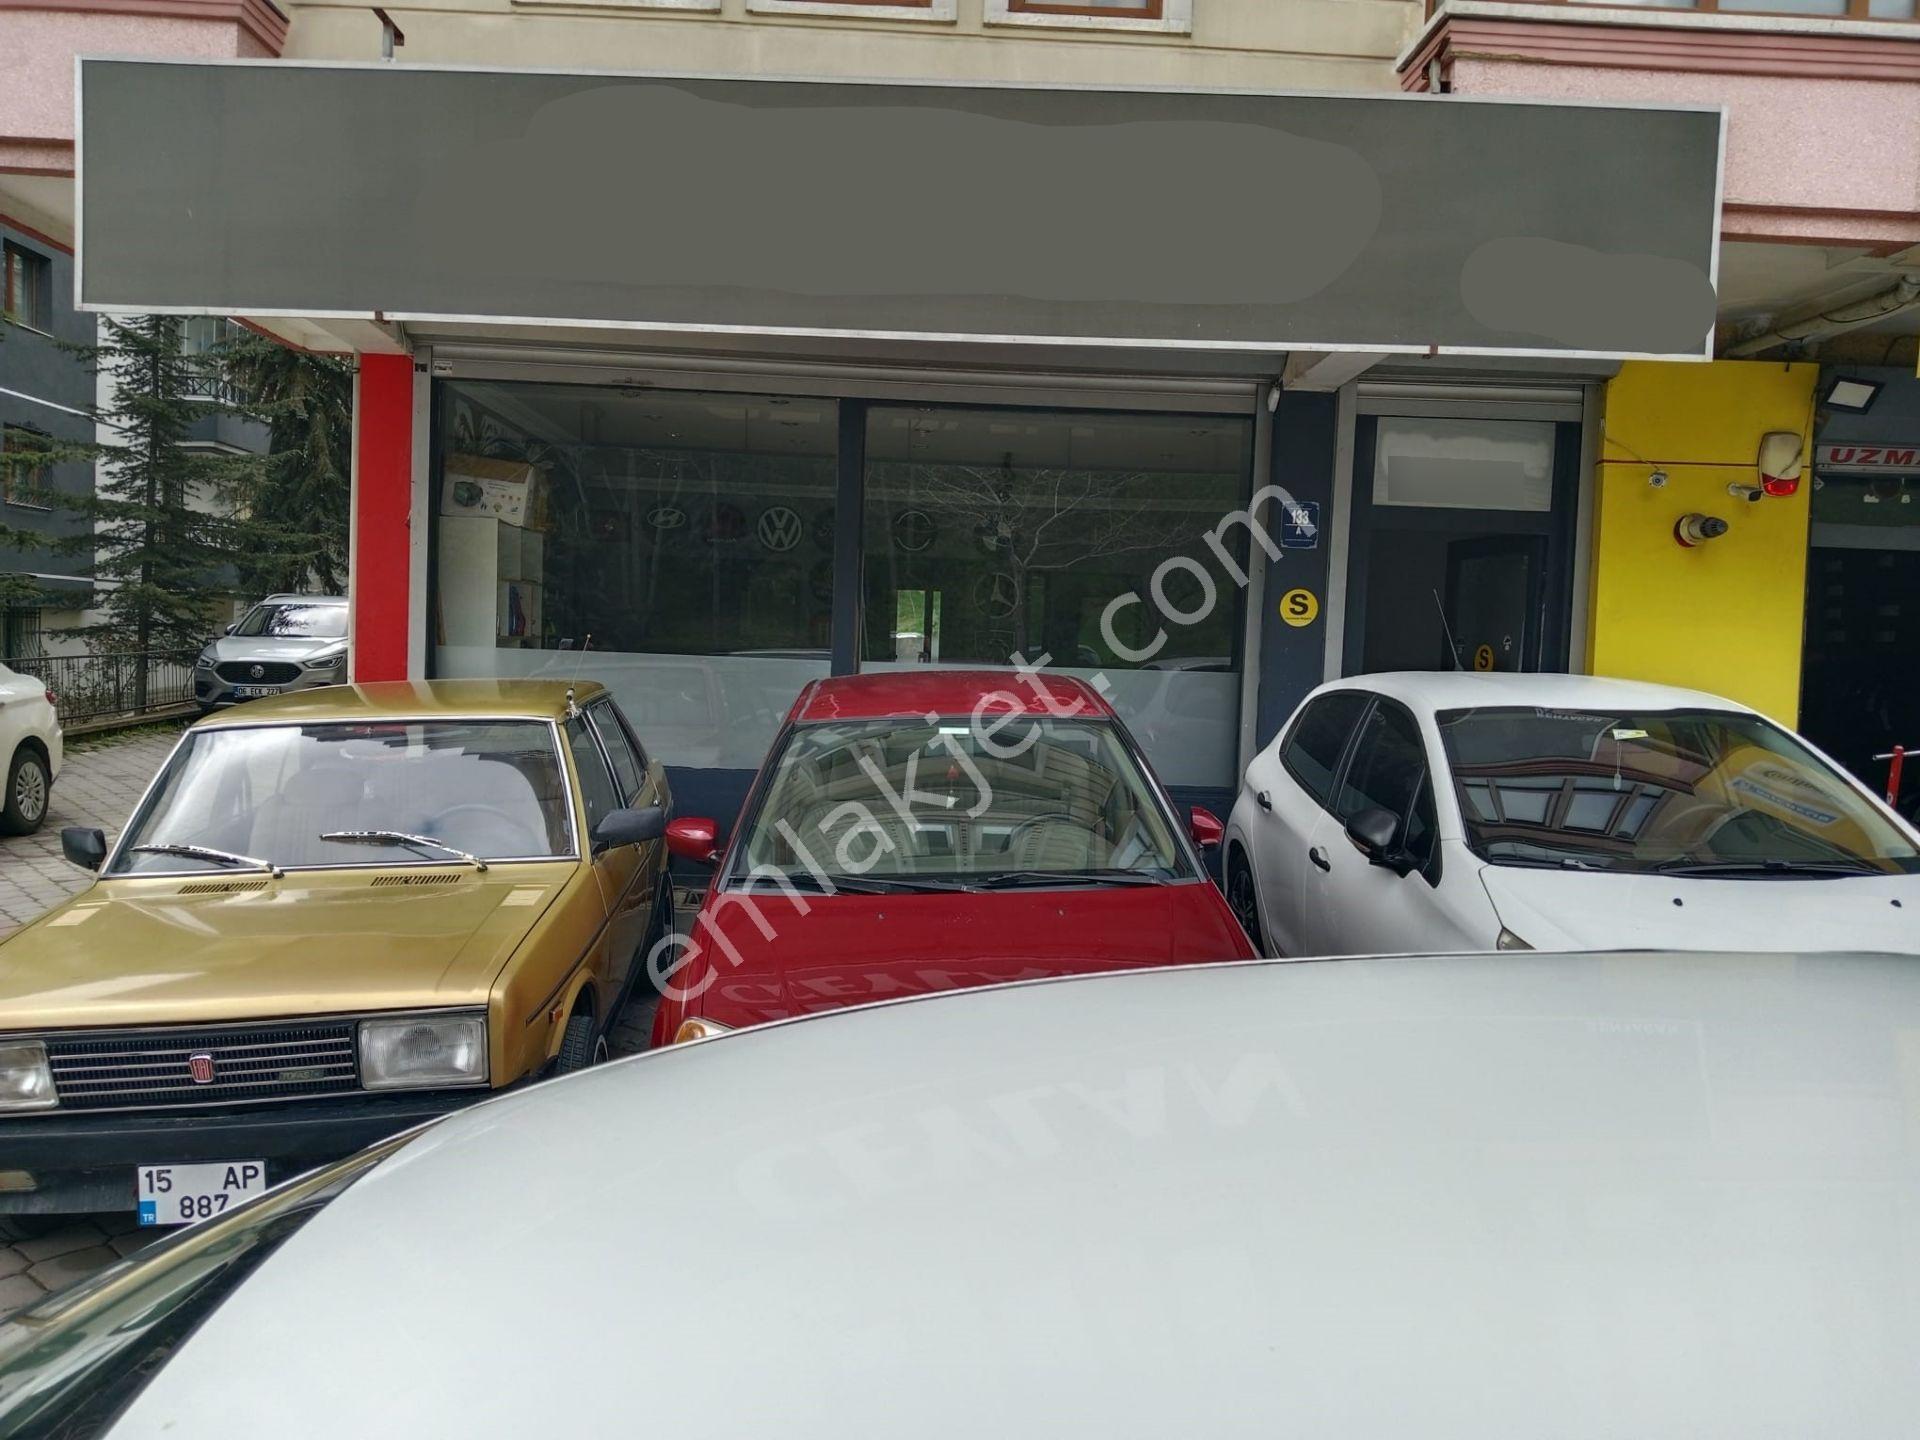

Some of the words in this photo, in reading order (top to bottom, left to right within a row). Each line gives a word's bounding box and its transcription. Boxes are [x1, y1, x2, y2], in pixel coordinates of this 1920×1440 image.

[1830, 448, 1920, 465] UZM
[1291, 509, 1309, 524] 133
[1290, 594, 1309, 615] S
[145, 1169, 172, 1193] 15
[223, 1165, 259, 1190] AP
[180, 1194, 229, 1219] 887
[143, 1213, 154, 1223] TR
